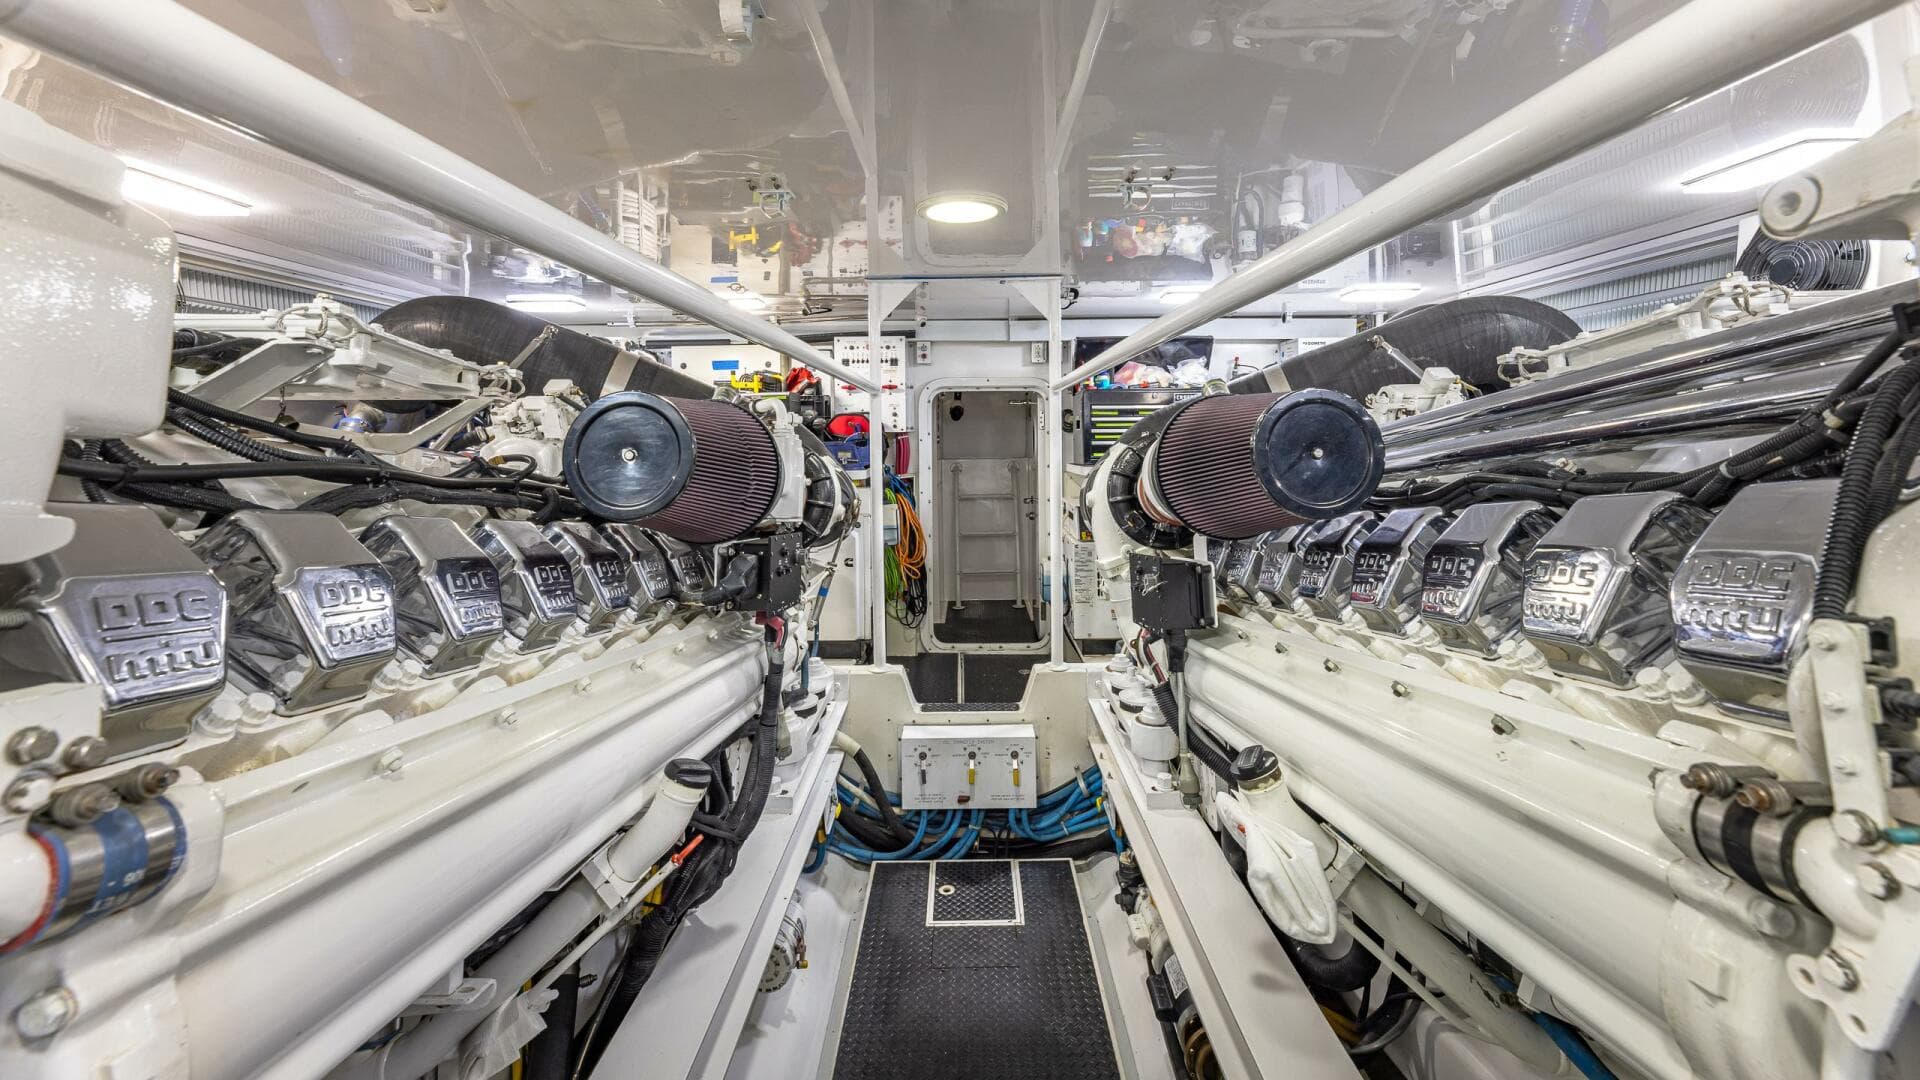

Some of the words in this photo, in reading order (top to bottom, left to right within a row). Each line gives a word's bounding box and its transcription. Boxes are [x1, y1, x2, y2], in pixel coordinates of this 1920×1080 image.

[446, 570, 500, 595] DDC
[1524, 560, 1599, 587] DDC
[1687, 559, 1796, 592] DDC
[315, 579, 385, 608] DDC
[97, 590, 211, 631] DDC
